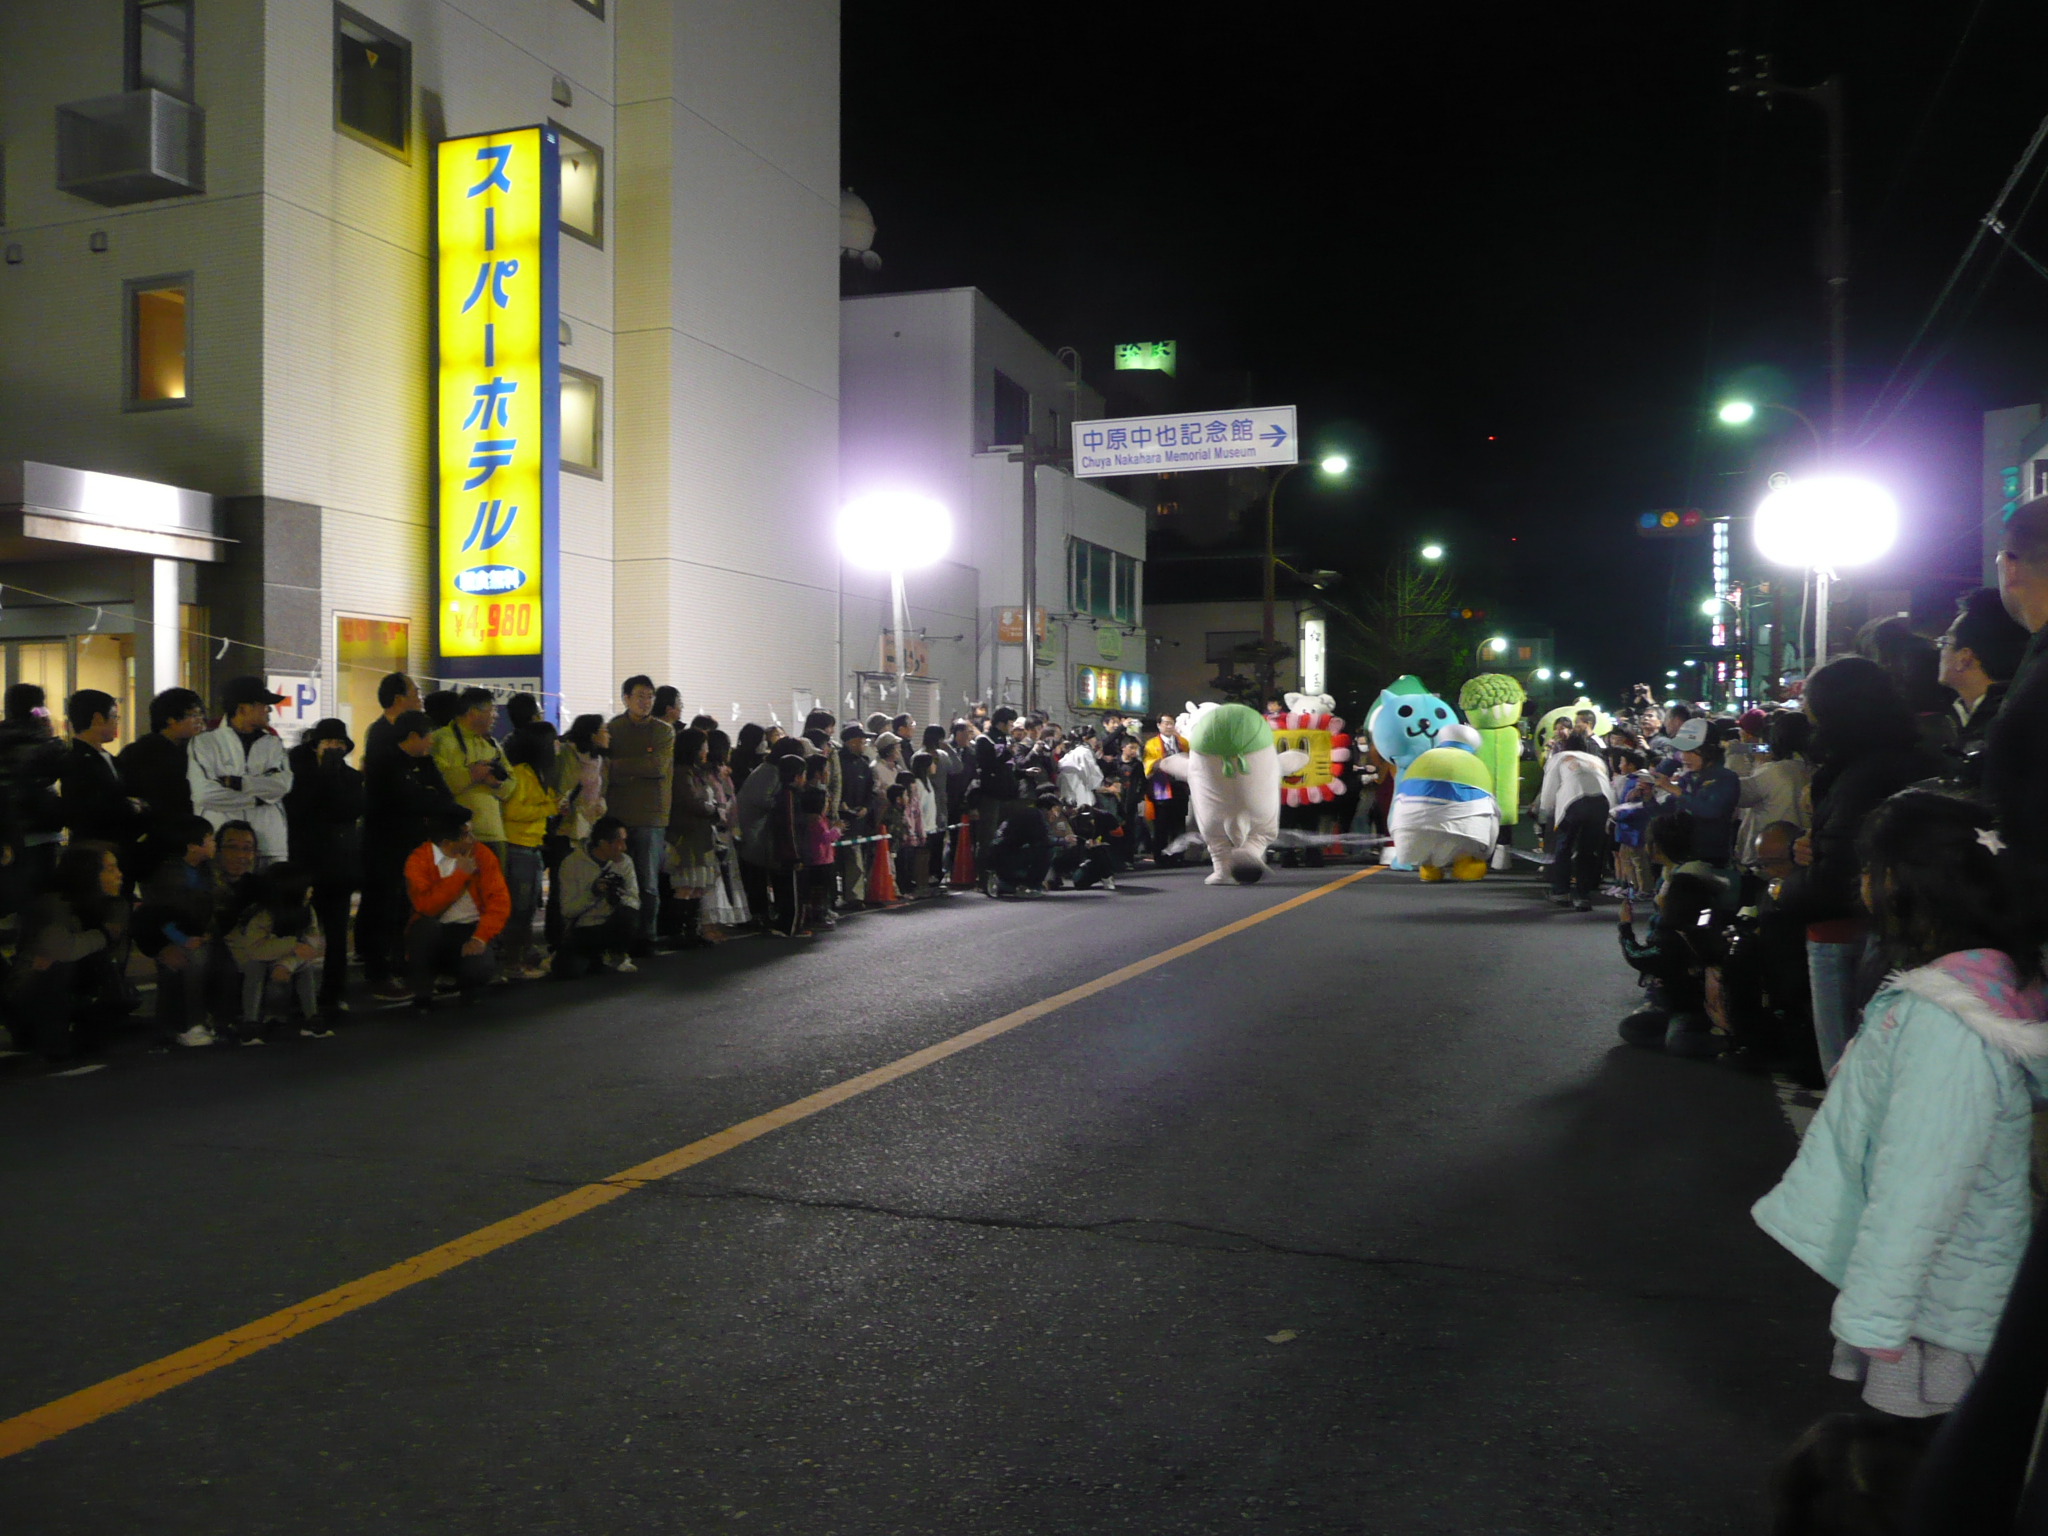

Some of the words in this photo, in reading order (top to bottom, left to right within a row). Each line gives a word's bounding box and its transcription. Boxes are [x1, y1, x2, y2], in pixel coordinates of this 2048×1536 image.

[460, 144, 519, 553] スーパーホテル
[1082, 418, 1255, 453] 中原中也記念館
[1081, 455, 1112, 470] Chuya
[1114, 452, 1162, 467] Nakahara
[1165, 447, 1212, 463] Memorial
[1214, 446, 1257, 460] Museum
[454, 603, 531, 642] ¥4,980
[296, 683, 317, 719] P
